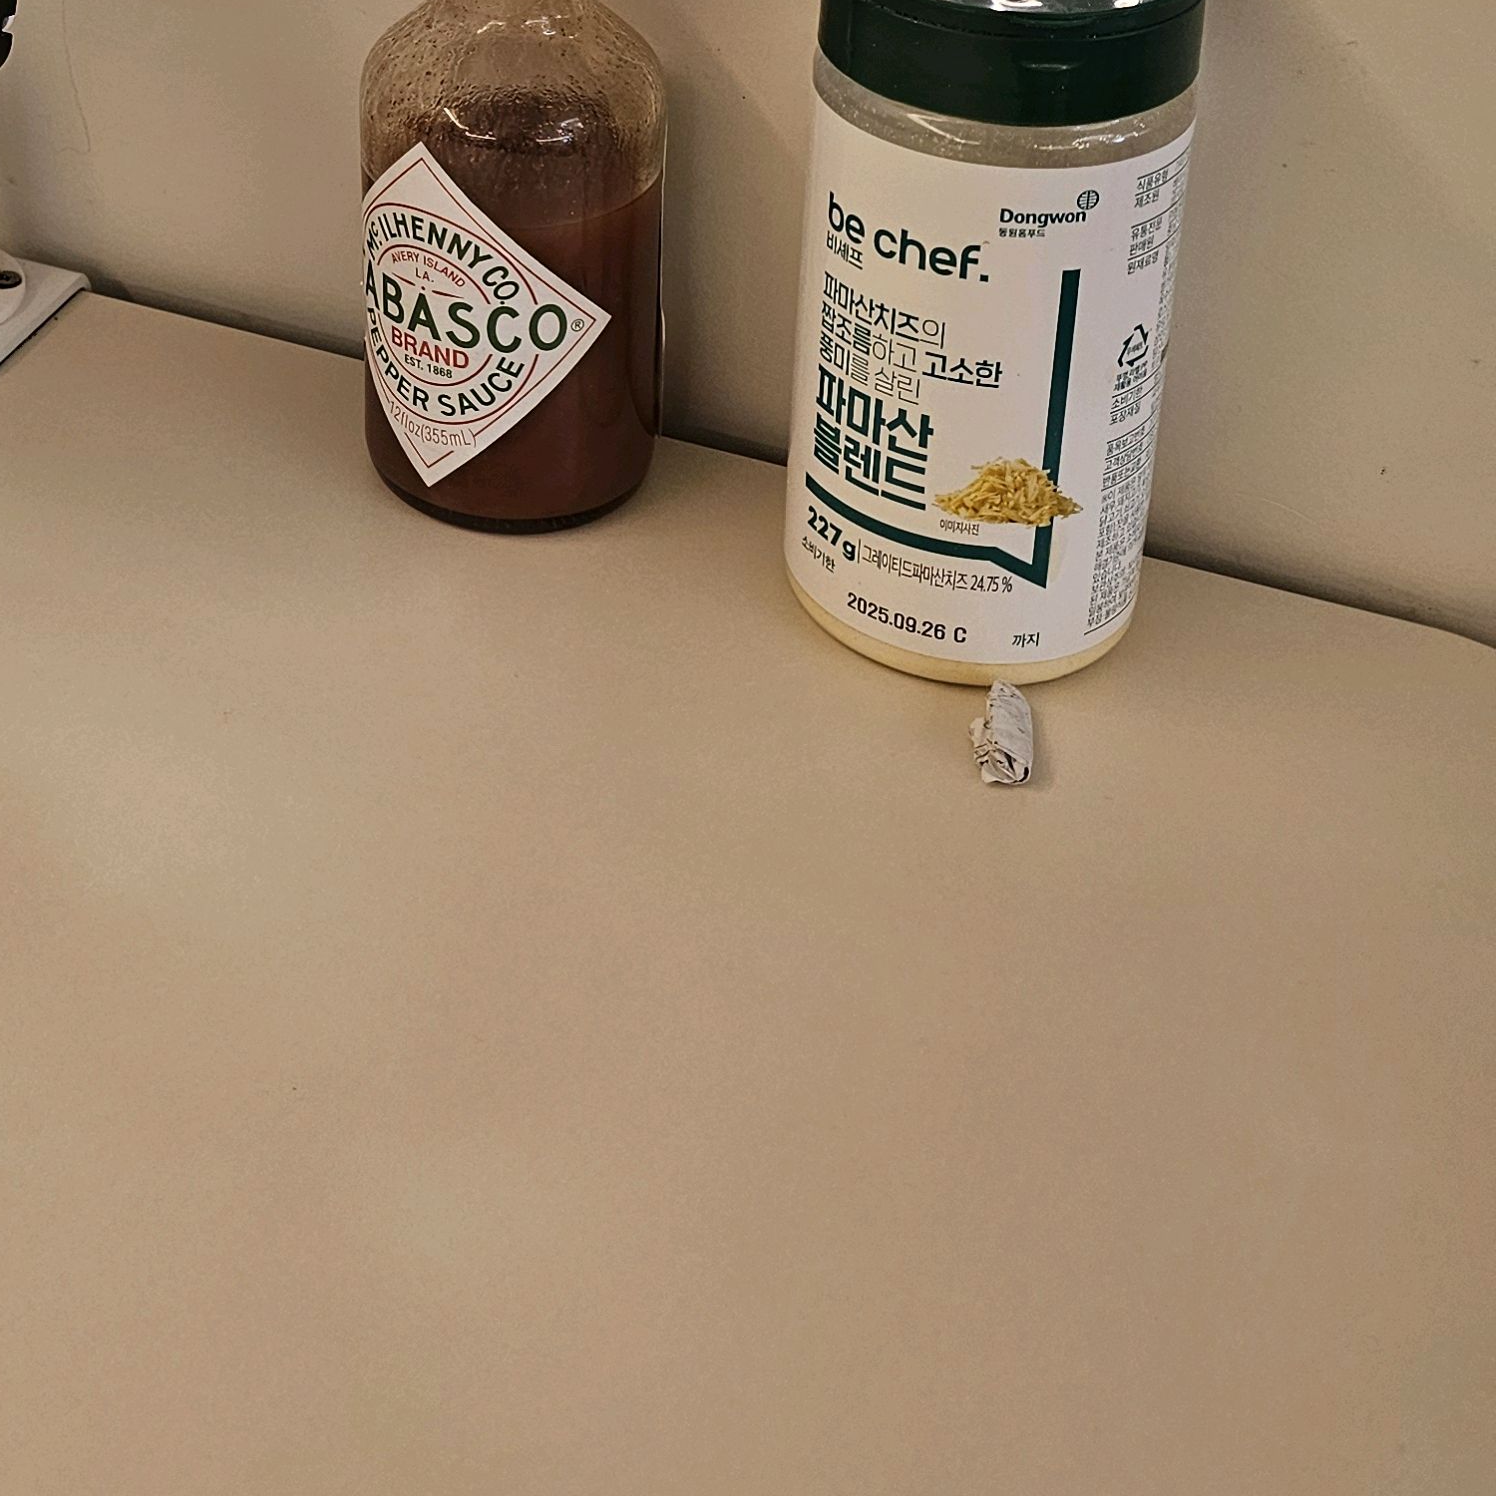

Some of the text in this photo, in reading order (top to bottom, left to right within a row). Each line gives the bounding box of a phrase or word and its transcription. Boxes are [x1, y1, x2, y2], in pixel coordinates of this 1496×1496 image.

[828, 191, 989, 282] be chef.
[999, 207, 1087, 228] Dongwon
[391, 250, 466, 288] AVERY ISLAND
[415, 267, 435, 283] LA.
[366, 260, 568, 354] ABASCO
[824, 270, 946, 349] 파마산치즈의
[366, 307, 525, 417] PEPPER SAUCE
[391, 326, 470, 369] BRAND
[404, 355, 453, 379] EST. 1868
[820, 331, 920, 405] 풍미를 살린
[821, 300, 1003, 388] 짭조름하고 고소한
[815, 363, 934, 462] 파마산
[814, 412, 926, 511] 블렌드
[807, 505, 843, 546] 227
[939, 519, 979, 536] 이미지사진
[802, 536, 836, 573] 소비기한
[862, 545, 968, 591] 그레이티드파마산치즈
[970, 575, 1000, 593] 24.75
[847, 592, 968, 644] 2025.09.26 C
[1011, 632, 1040, 648] 까지
